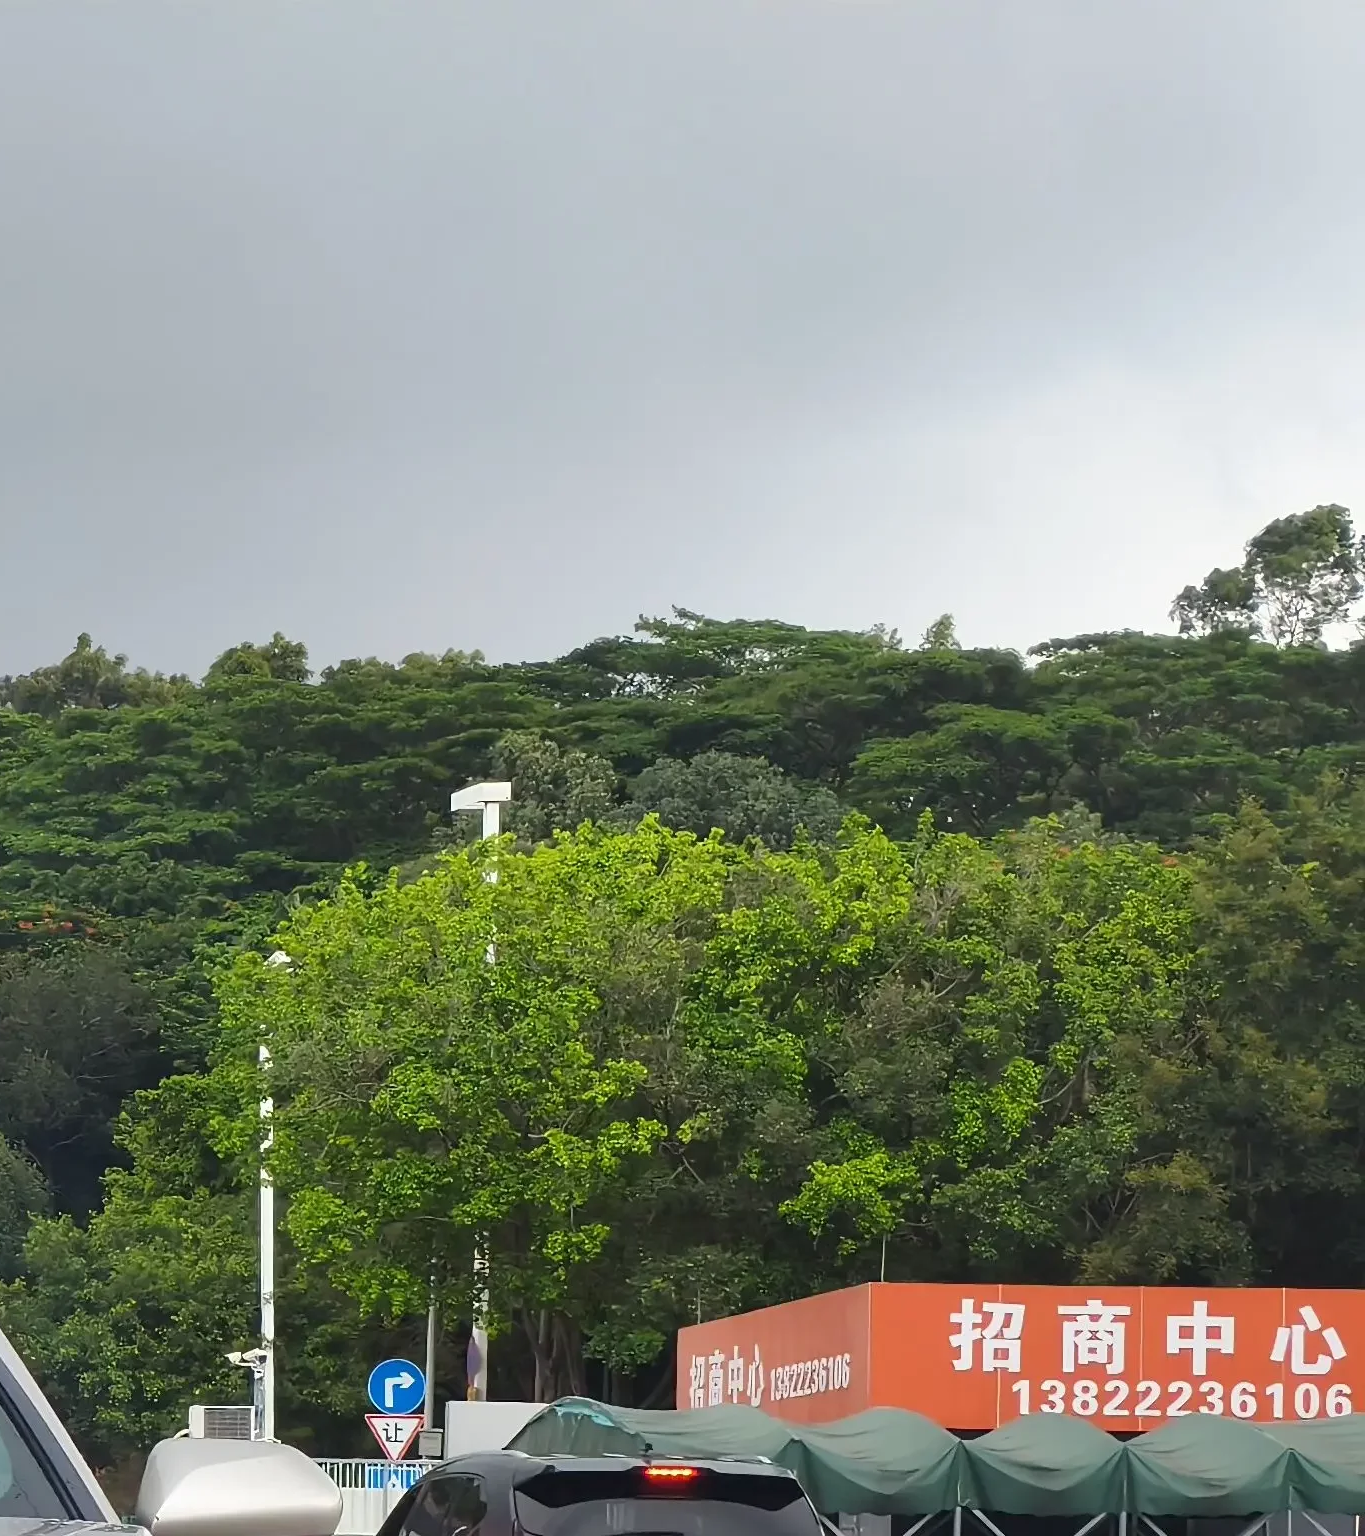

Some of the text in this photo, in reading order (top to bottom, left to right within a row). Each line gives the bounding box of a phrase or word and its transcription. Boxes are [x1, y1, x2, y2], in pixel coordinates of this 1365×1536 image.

[949, 1298, 1347, 1376] 招商中心
[689, 1343, 851, 1409] 招商中心 13822236106
[1011, 1379, 1353, 1419] 13822236106
[382, 1422, 404, 1443] 让
